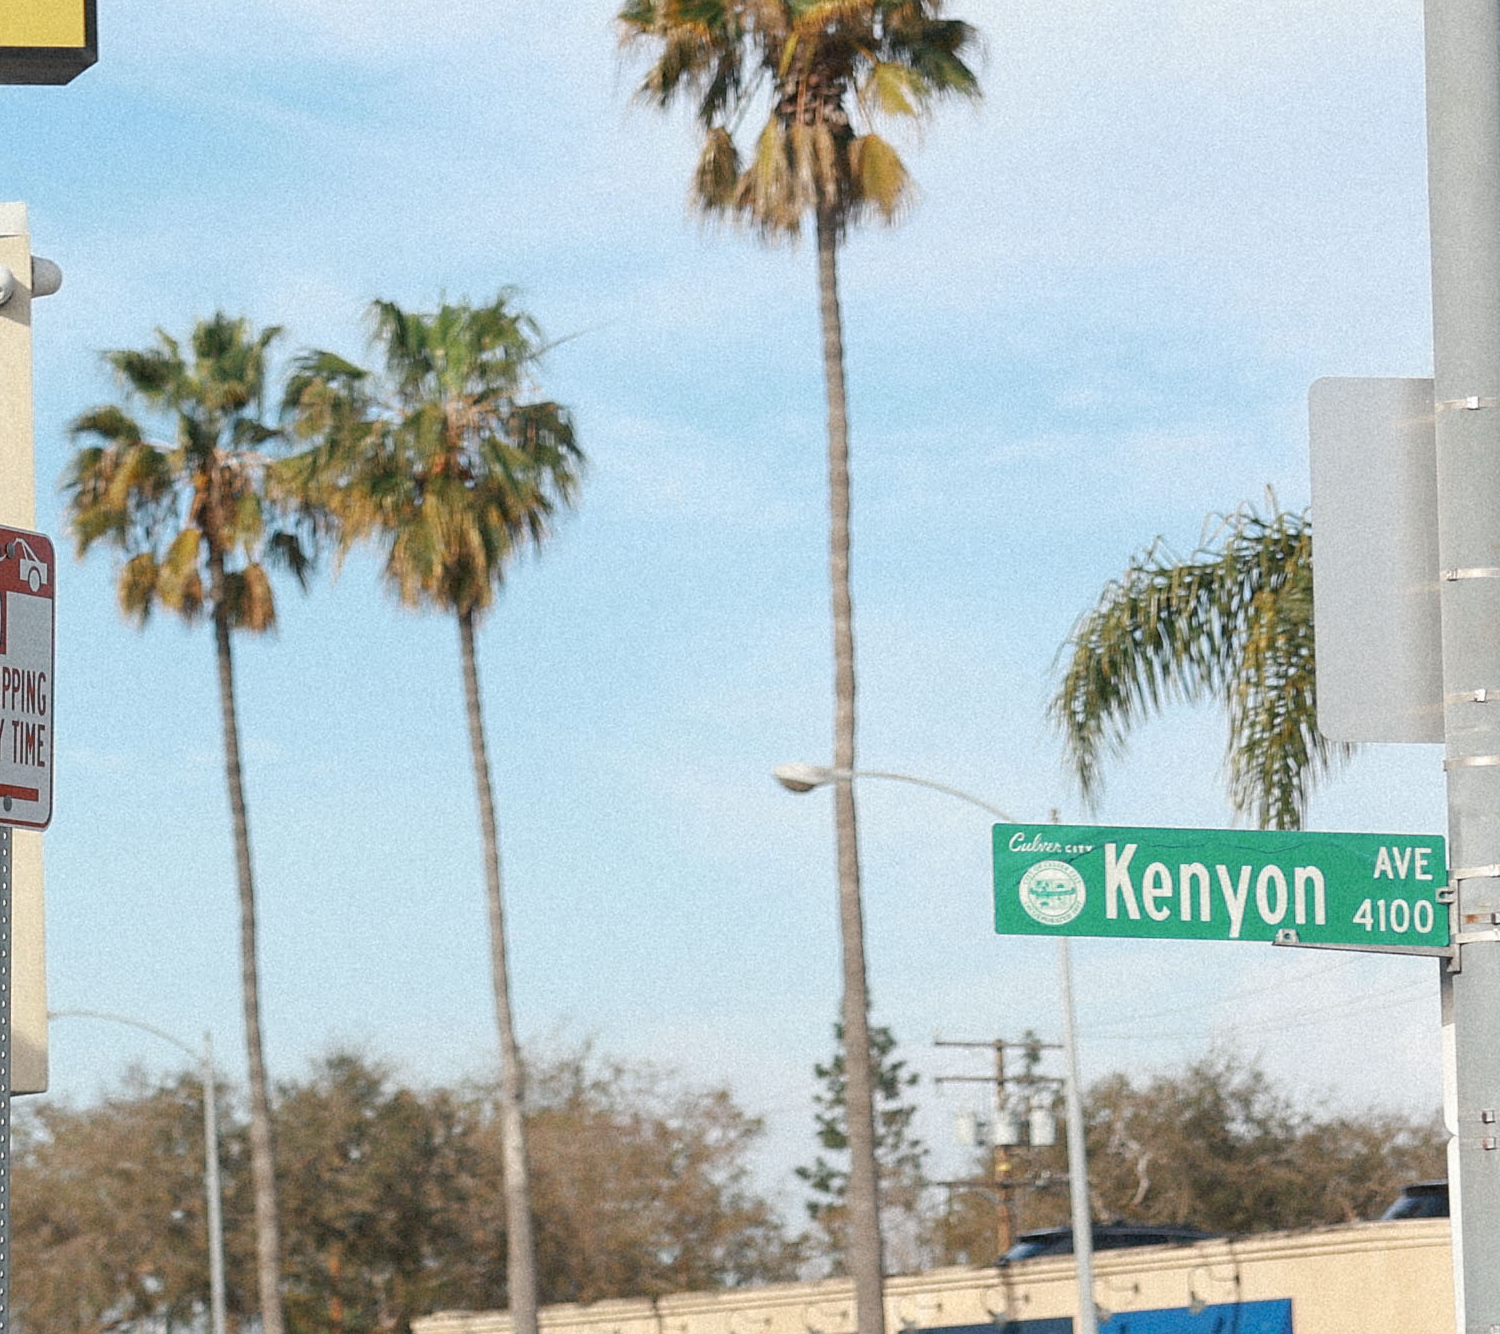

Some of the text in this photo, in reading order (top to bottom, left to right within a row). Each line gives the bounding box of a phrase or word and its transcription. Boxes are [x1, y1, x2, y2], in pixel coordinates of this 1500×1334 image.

[12, 720, 46, 768] TIME
[1009, 832, 1062, 853] Culver
[1373, 847, 1433, 881] AVE
[1105, 842, 1326, 938] Kenyon
[1353, 899, 1435, 934] 4100
